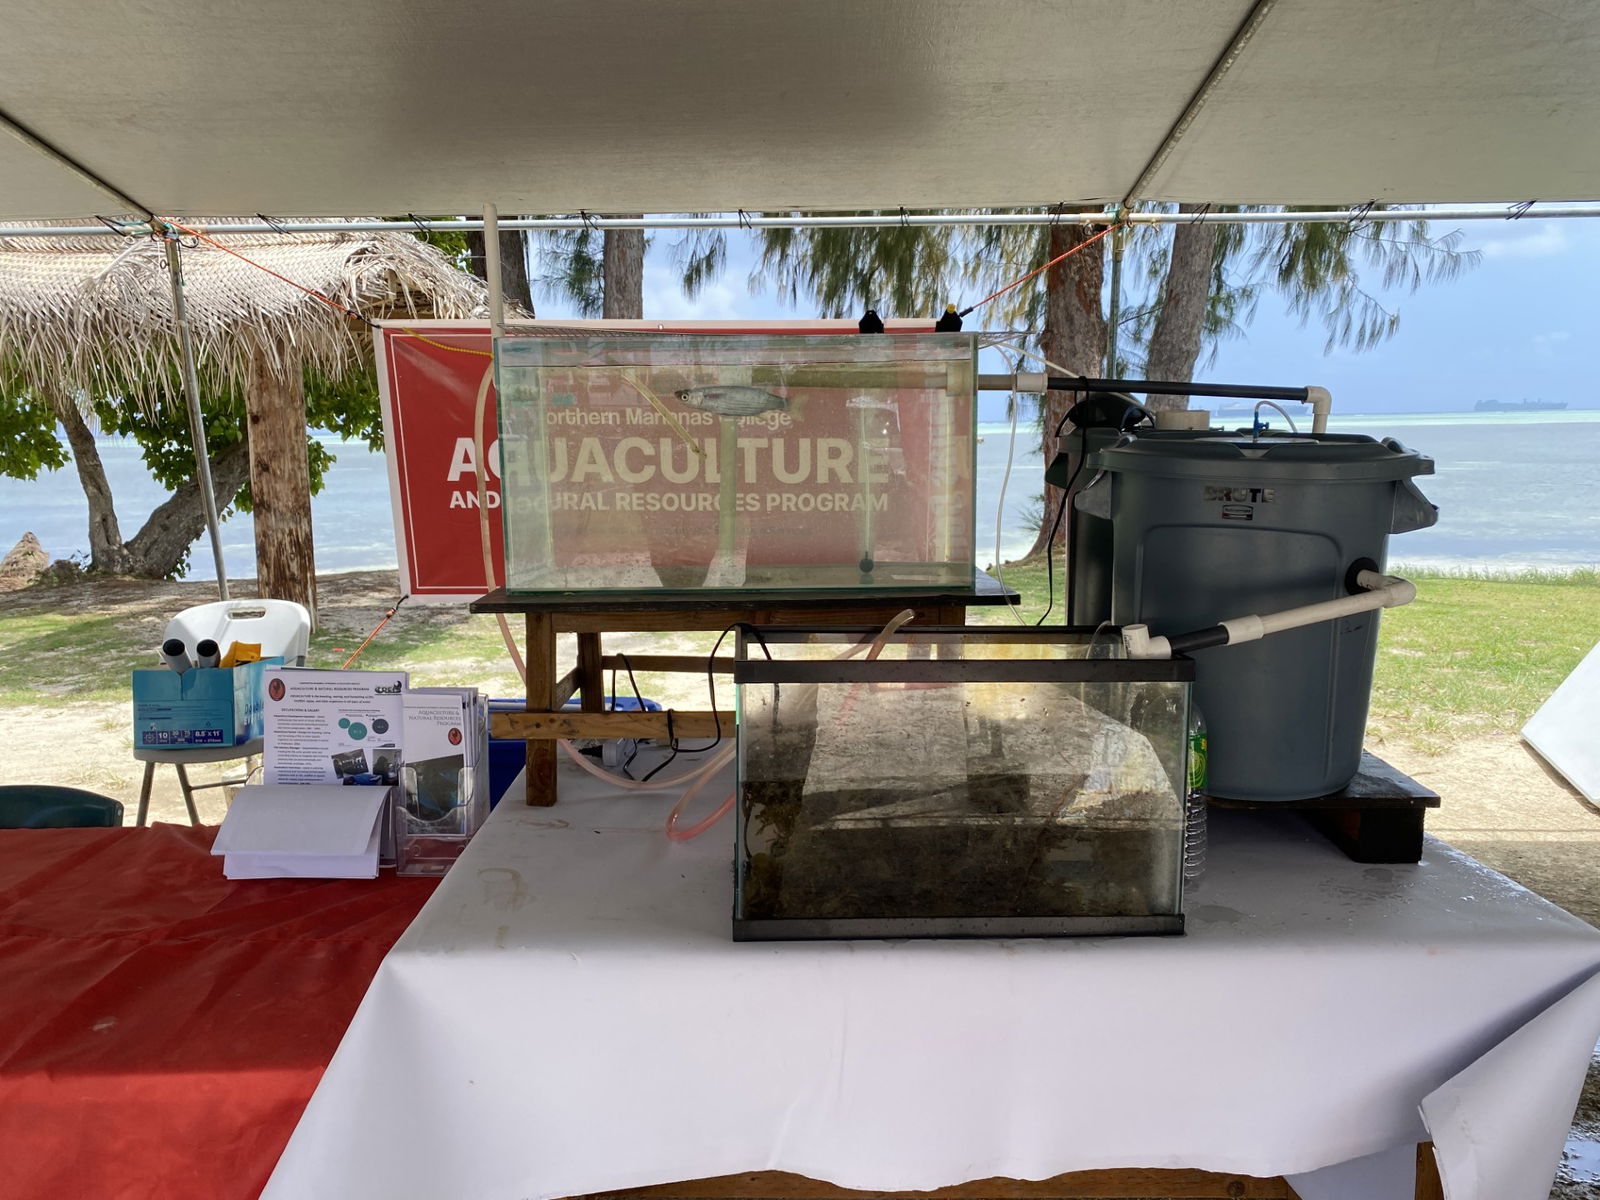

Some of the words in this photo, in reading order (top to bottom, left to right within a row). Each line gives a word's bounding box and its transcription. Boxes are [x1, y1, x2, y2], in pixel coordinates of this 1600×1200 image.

[546, 407, 621, 426] orthern
[450, 490, 500, 509] AND
[766, 493, 889, 512] PROGRAM
